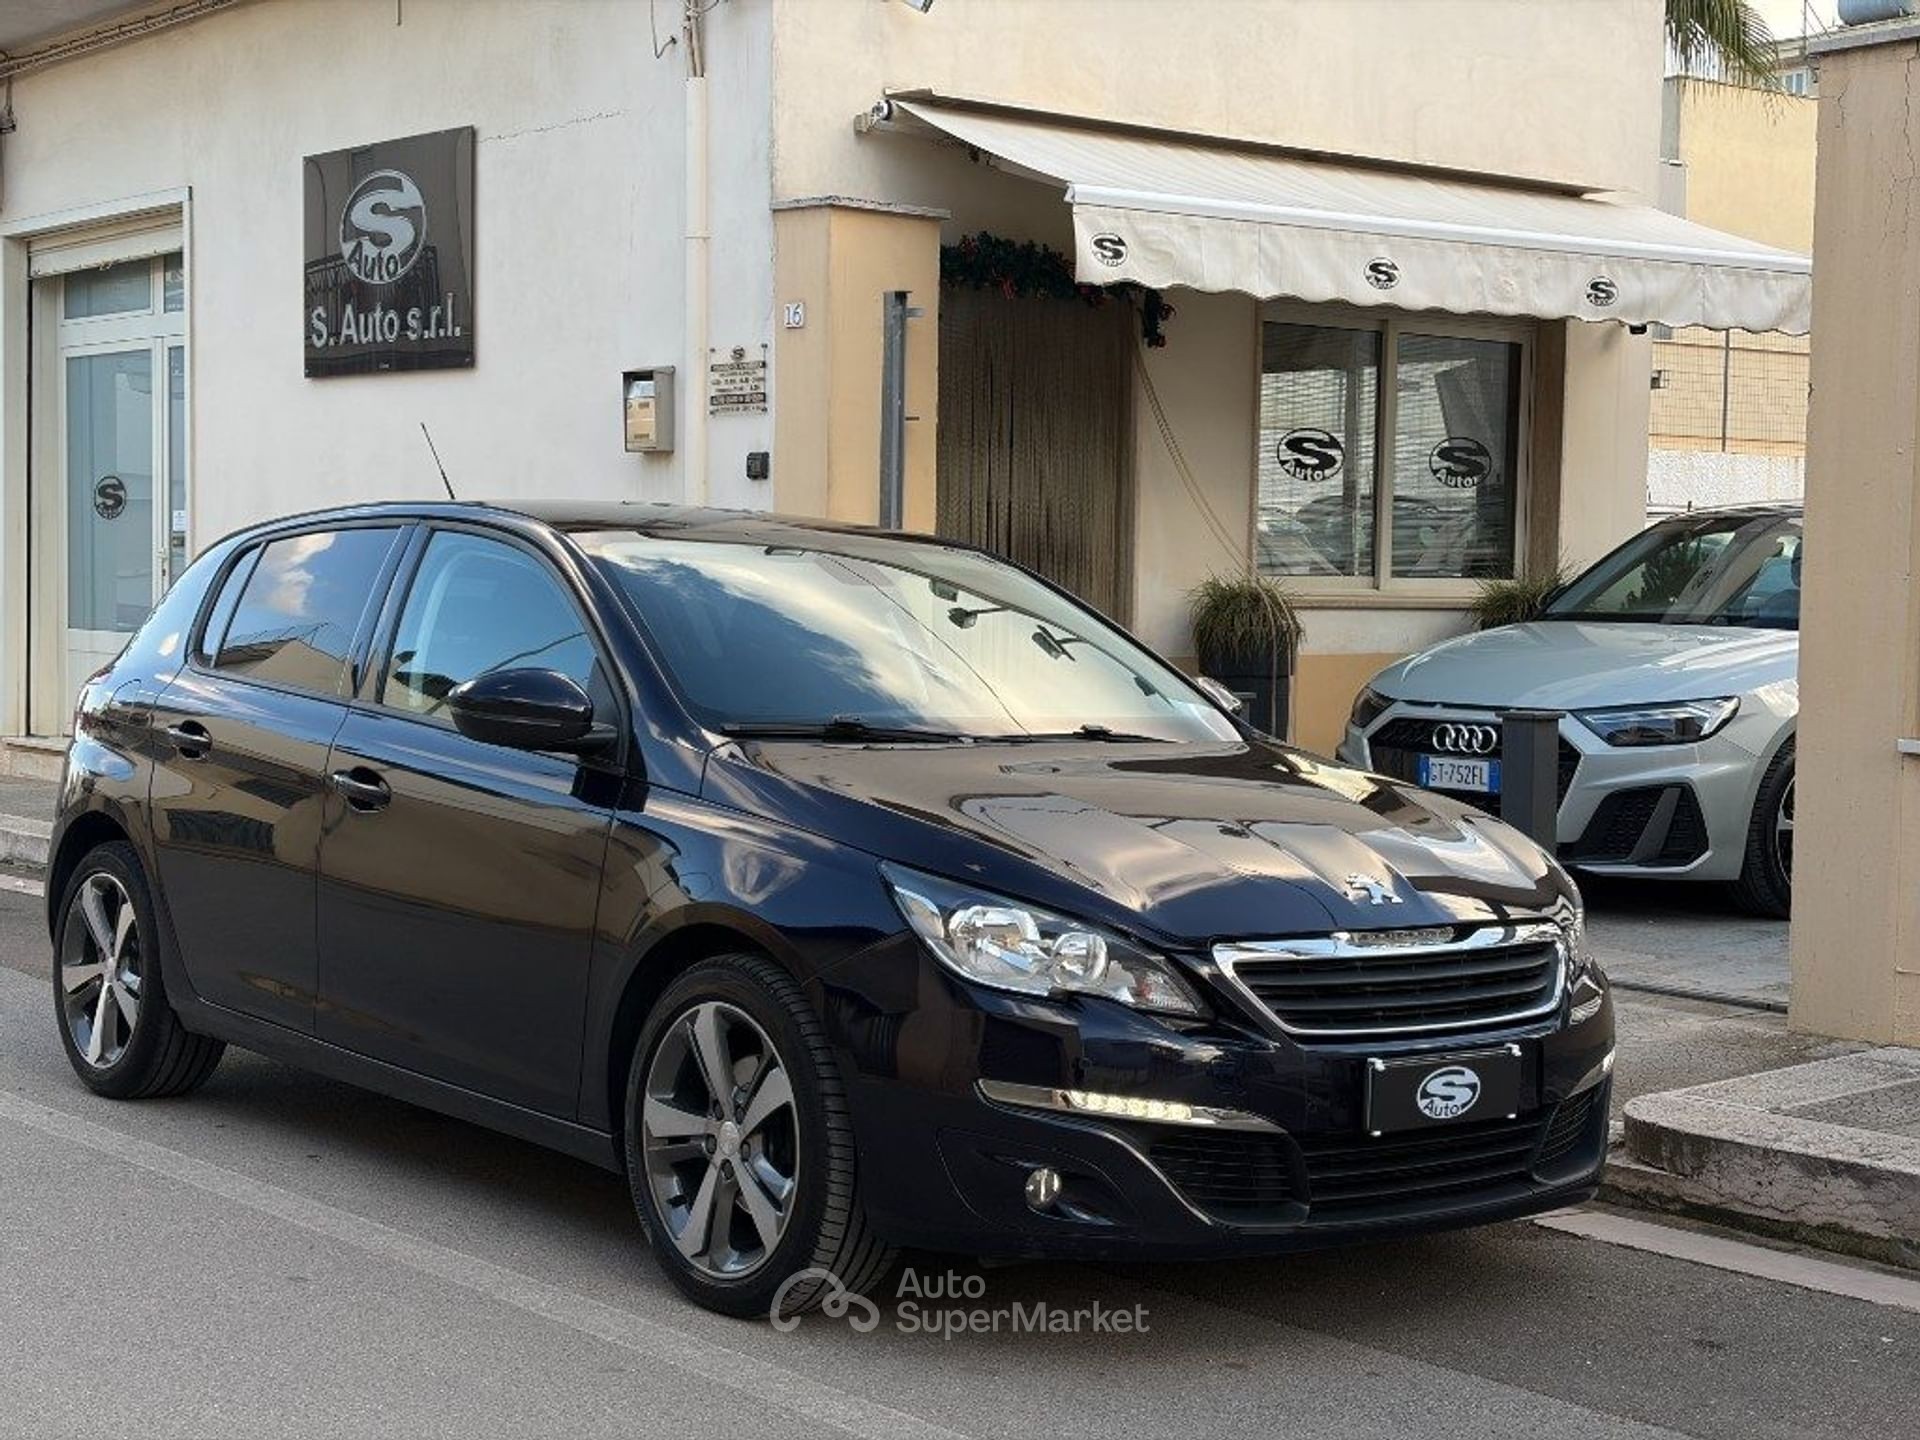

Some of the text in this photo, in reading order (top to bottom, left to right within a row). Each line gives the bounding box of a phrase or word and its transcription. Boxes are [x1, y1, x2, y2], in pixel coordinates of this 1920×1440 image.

[350, 240, 399, 281] Auto
[311, 292, 462, 348] S. Auto s.r.l.
[785, 304, 802, 326] 16
[1282, 460, 1324, 481] Auto
[1435, 469, 1474, 488] Auto
[1423, 1099, 1460, 1117] Auto
